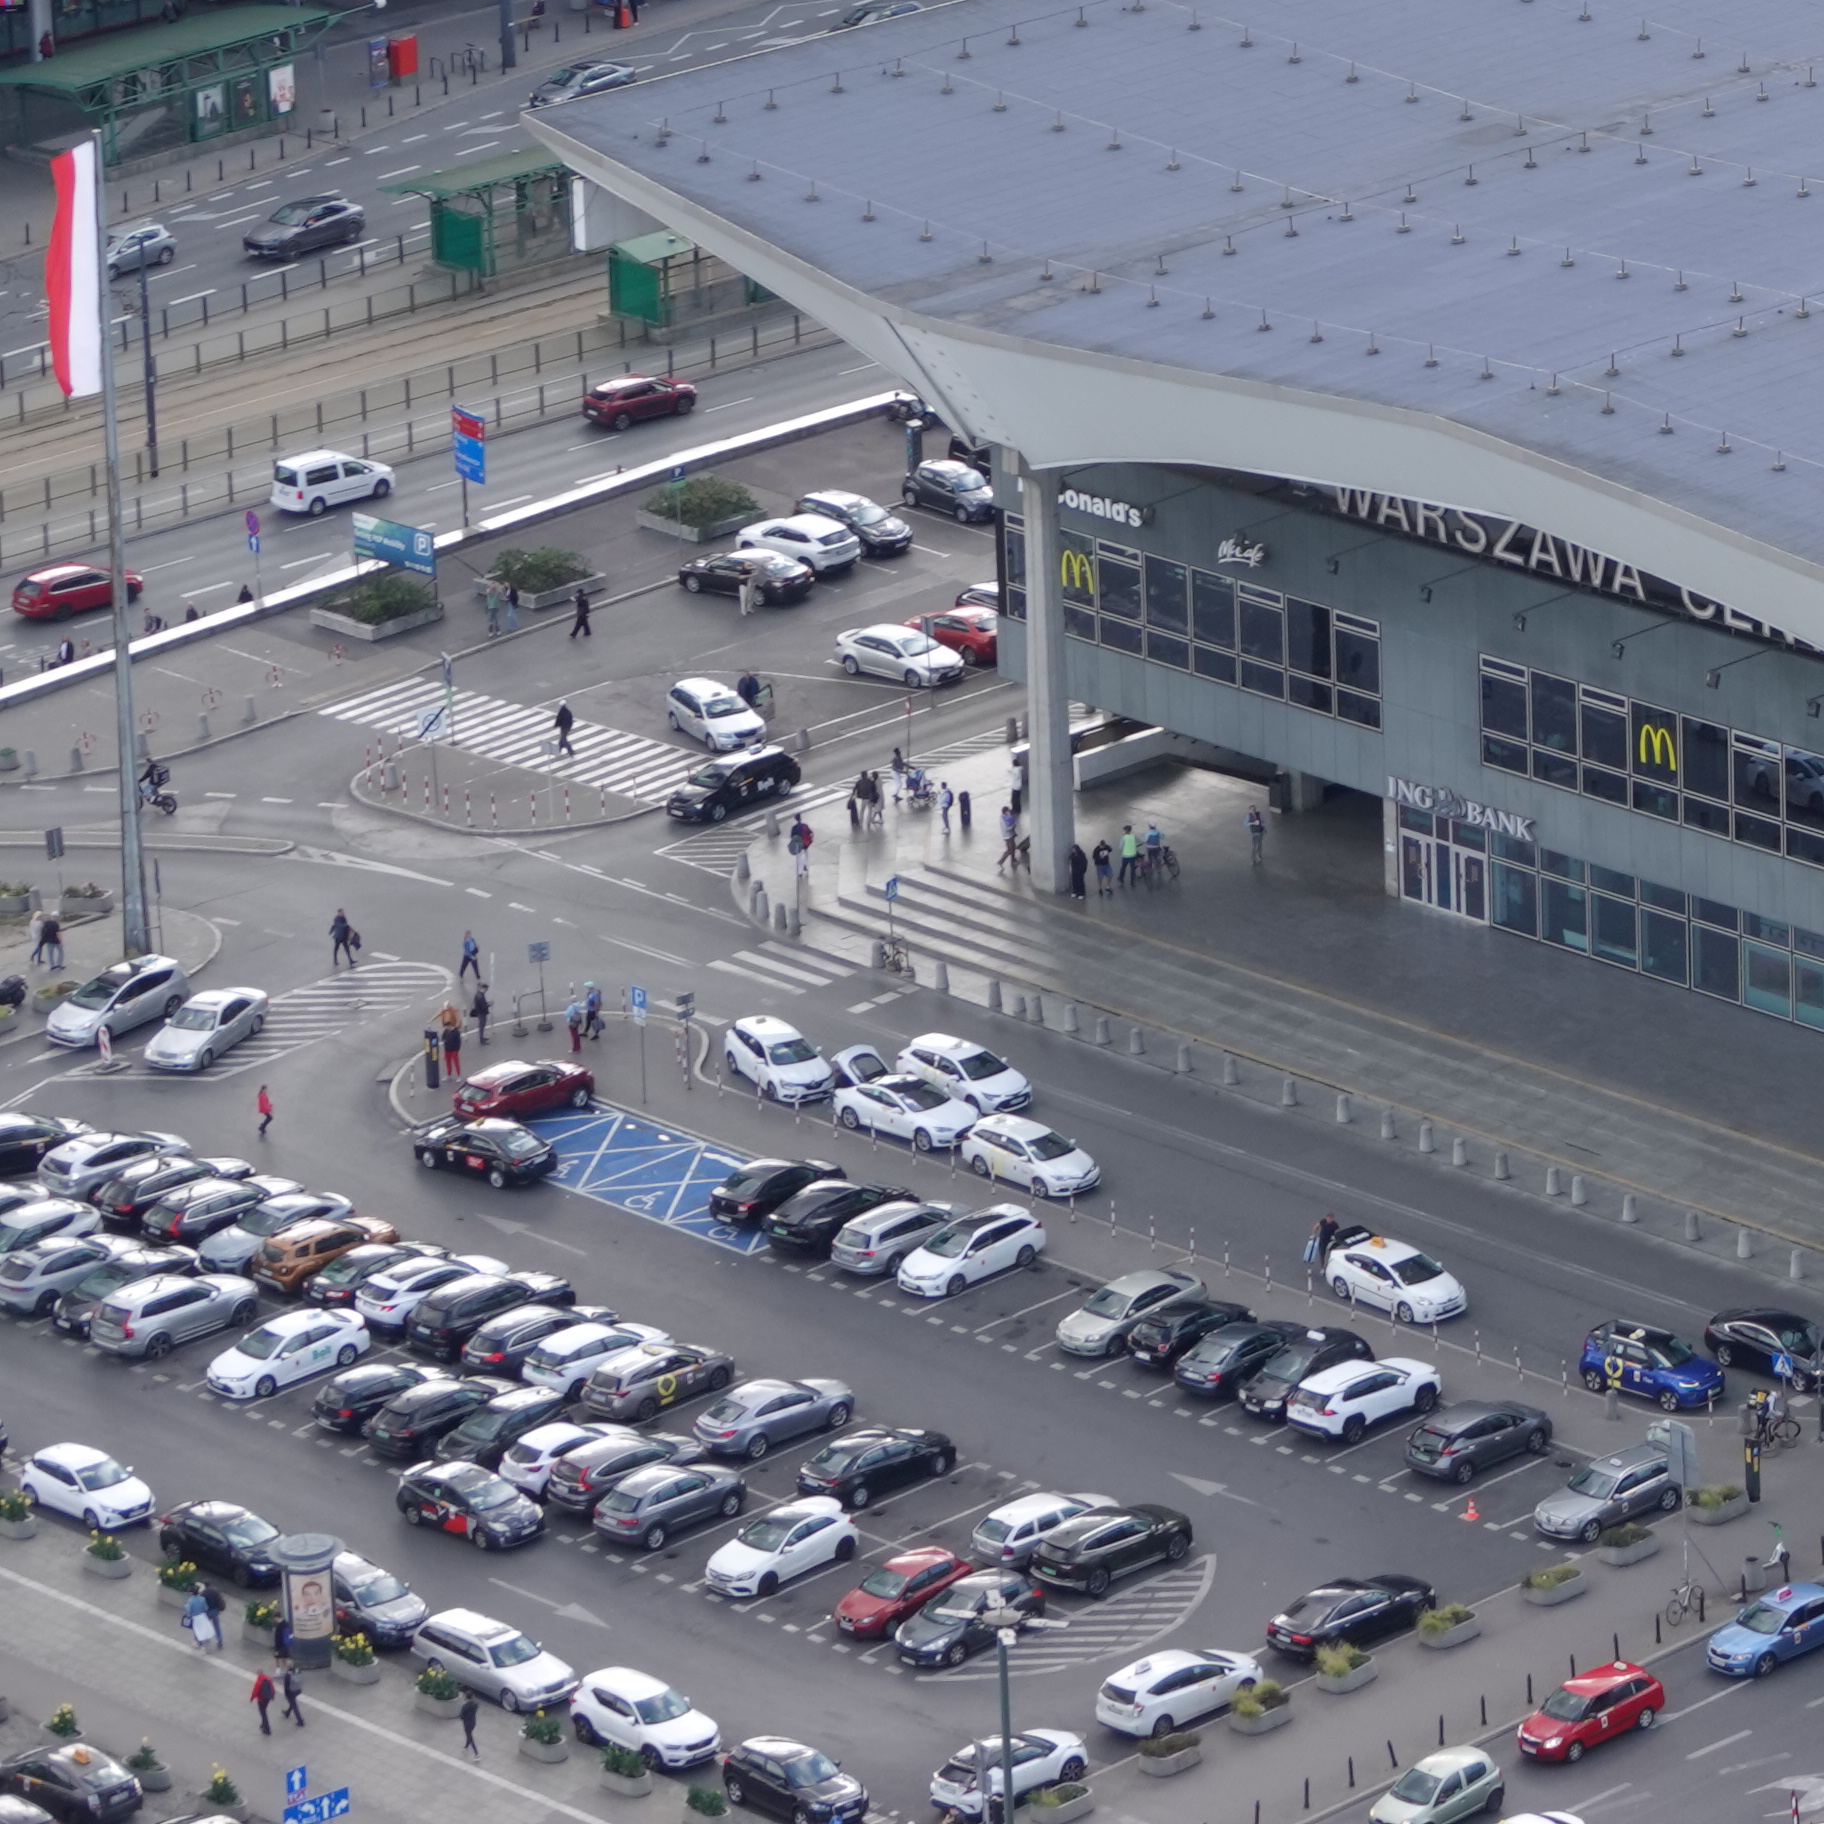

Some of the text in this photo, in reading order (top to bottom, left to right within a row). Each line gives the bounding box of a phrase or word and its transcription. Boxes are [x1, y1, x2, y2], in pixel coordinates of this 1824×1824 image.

[1335, 486, 1646, 600] WARSZAWA
[1387, 776, 1535, 842] ING BANK
